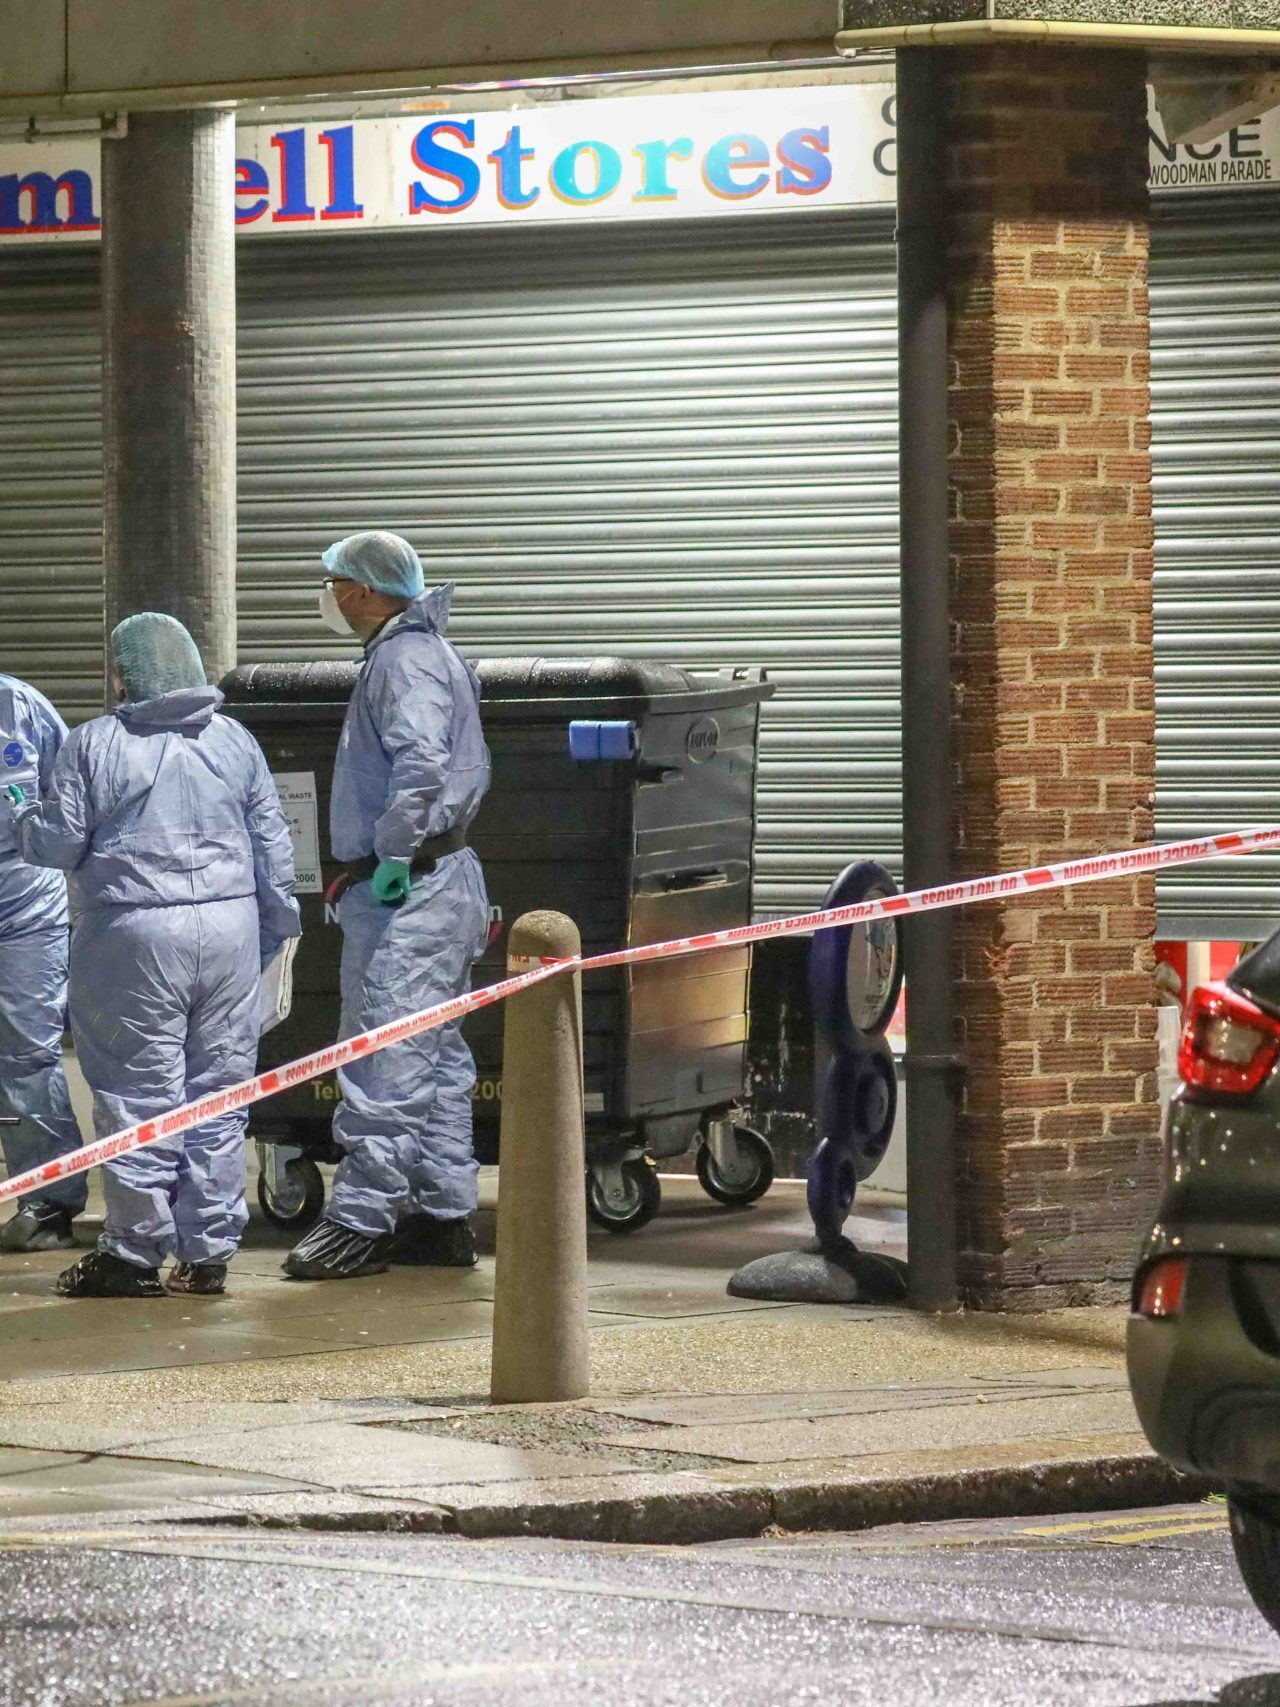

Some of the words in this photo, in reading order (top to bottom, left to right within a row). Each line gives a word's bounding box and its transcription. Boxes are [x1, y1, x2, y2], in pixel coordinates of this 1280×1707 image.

[408, 118, 833, 215] Stores
[1150, 162, 1217, 185] WOODMAN
[1221, 159, 1272, 181] PARADE
[290, 791, 312, 800] WASTE
